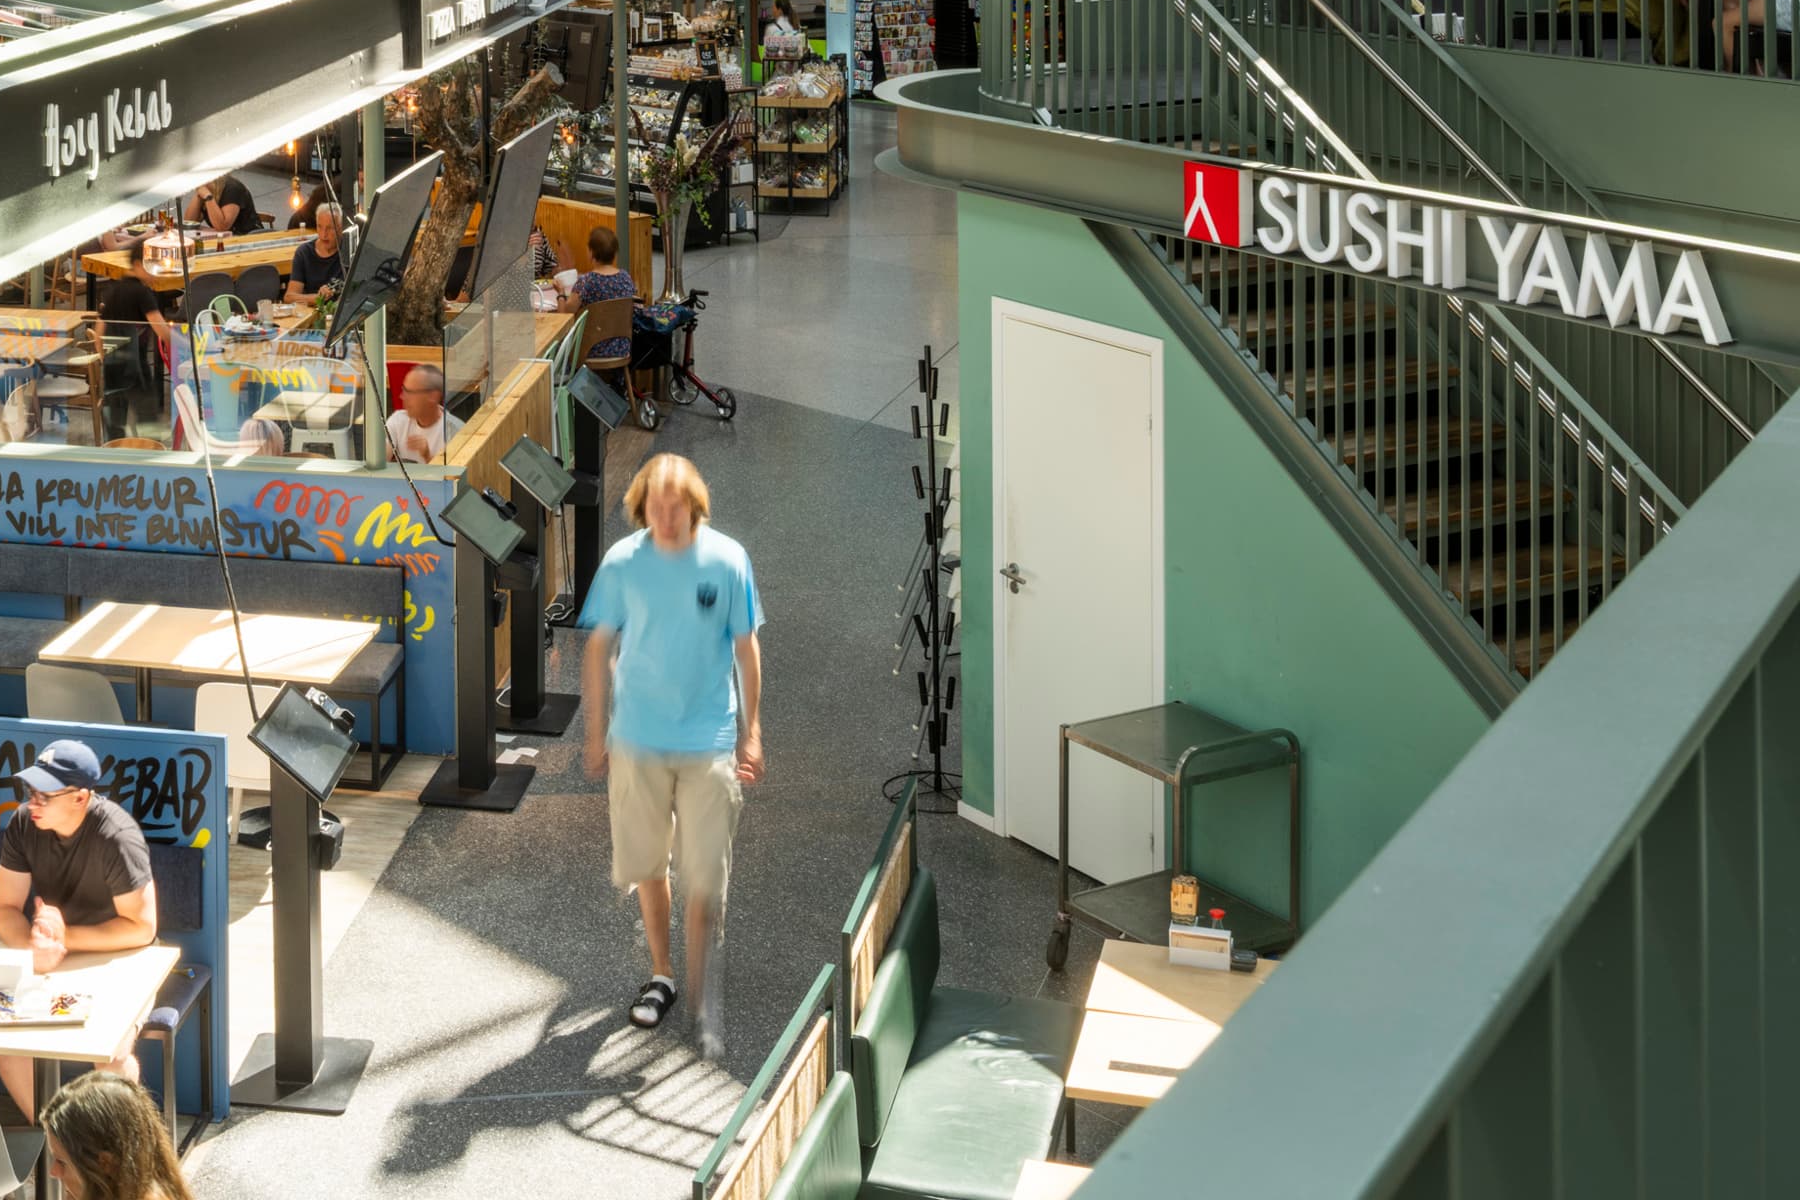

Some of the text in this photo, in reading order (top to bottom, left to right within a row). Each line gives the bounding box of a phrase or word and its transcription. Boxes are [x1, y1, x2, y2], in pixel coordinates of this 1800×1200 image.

[107, 79, 172, 153] Kebab
[1257, 176, 1734, 346] SUSHI YAMA
[36, 474, 205, 518] KRUMELUR
[6, 510, 66, 538] VILL
[76, 513, 136, 542] INTE
[220, 508, 316, 560] STUR
